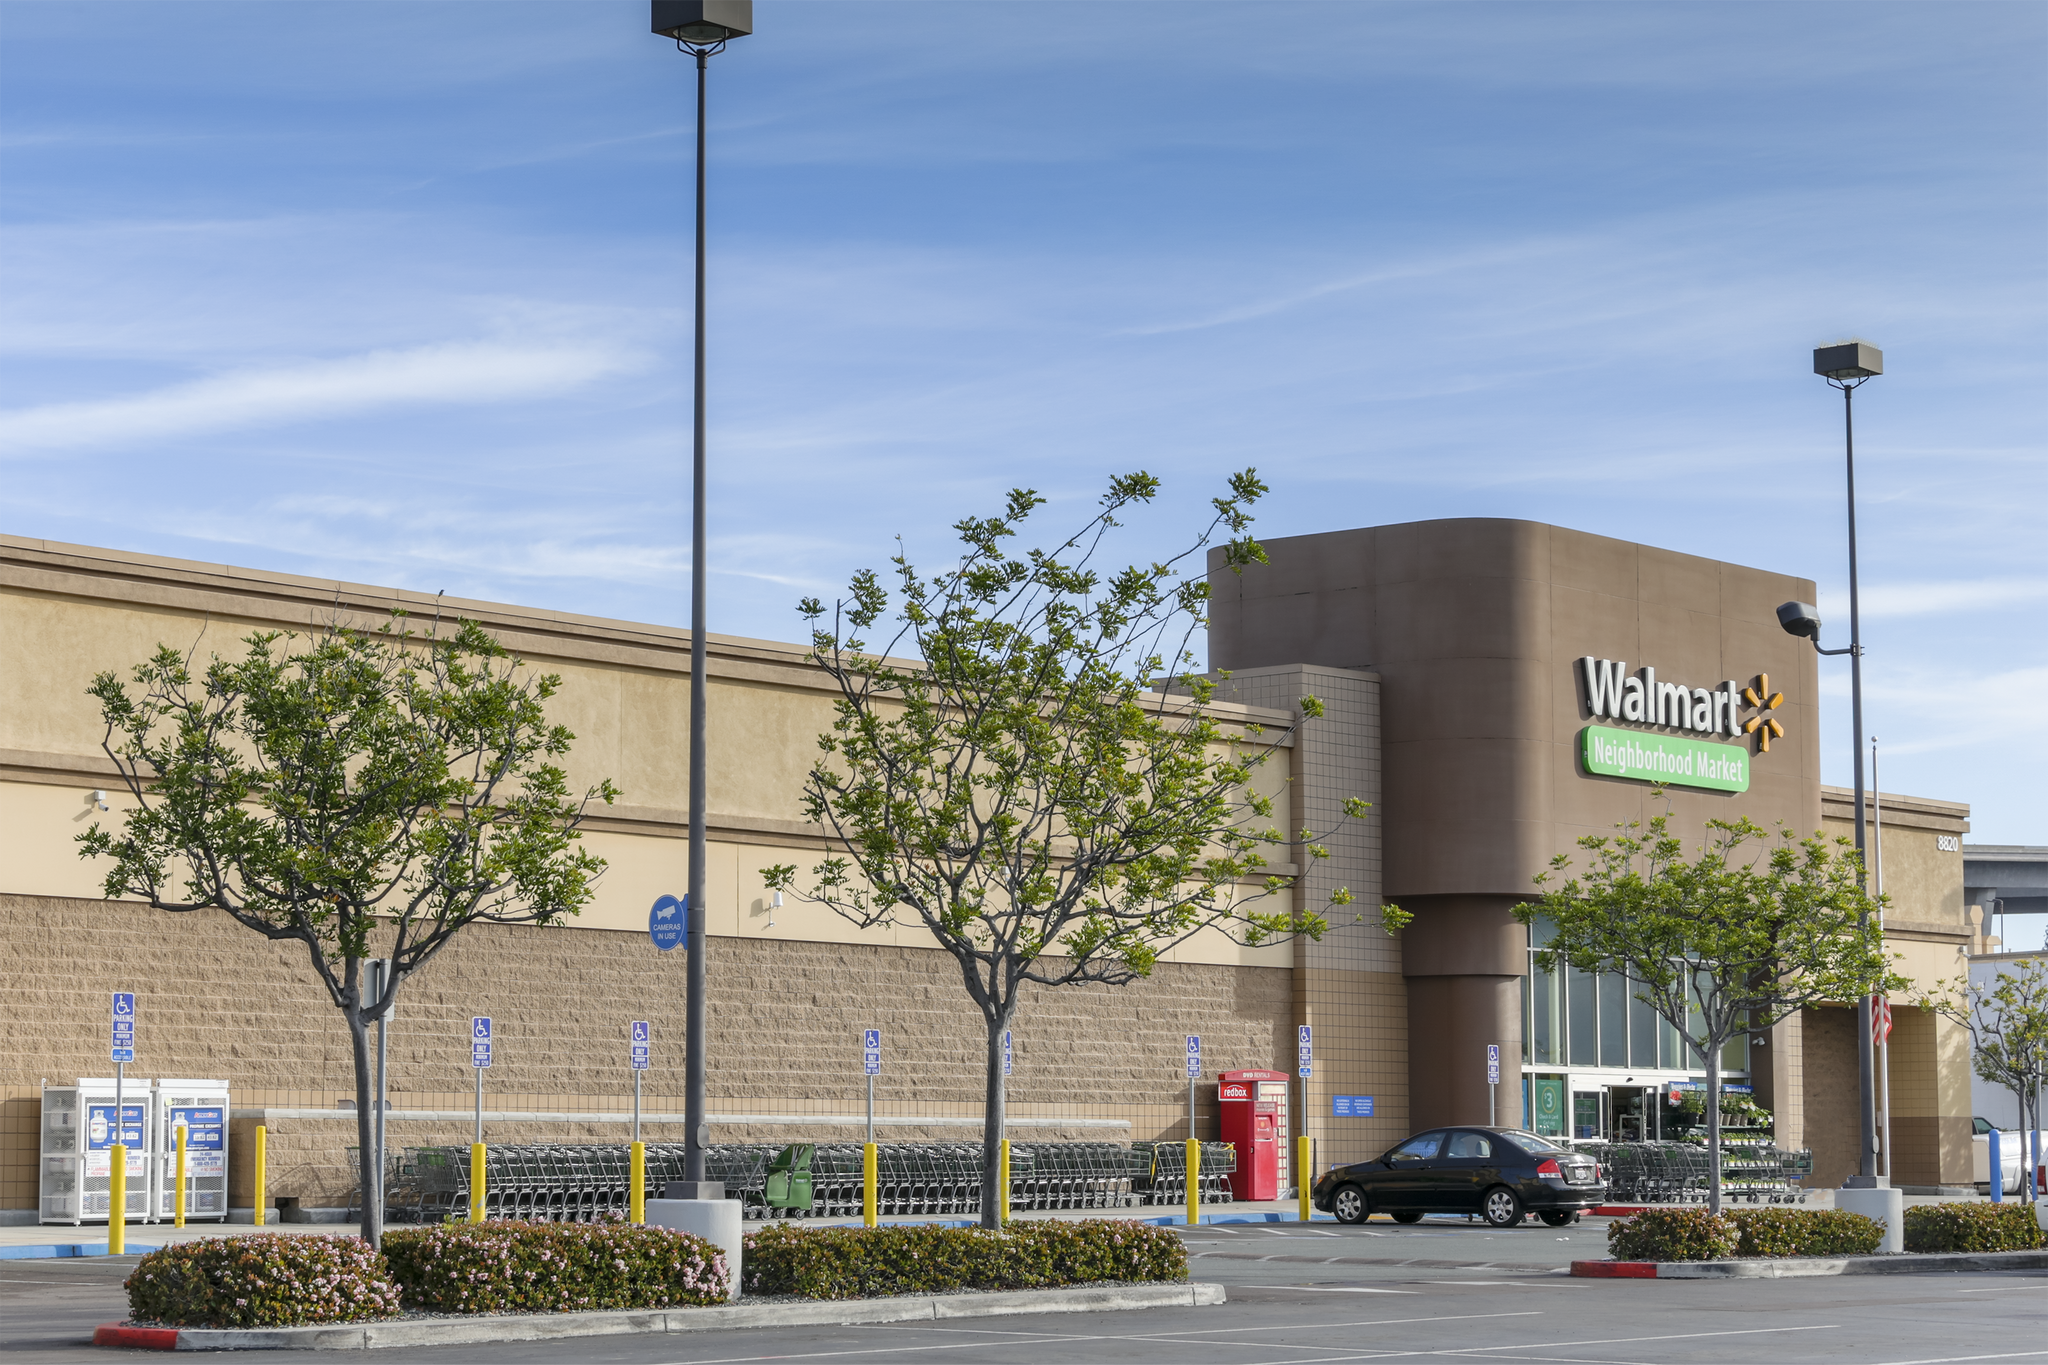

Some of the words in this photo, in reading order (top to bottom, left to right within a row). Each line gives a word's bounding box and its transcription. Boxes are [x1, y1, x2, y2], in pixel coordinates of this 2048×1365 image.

[1585, 656, 1741, 736] Walmart
[1594, 736, 1692, 776] Neighborhood
[1697, 751, 1743, 782] Market
[1938, 835, 1959, 852] 8820
[653, 923, 681, 931] CAMERAS
[657, 932, 664, 940] IN
[664, 932, 676, 940] USE
[113, 1014, 133, 1022] PARKING
[117, 1022, 129, 1031] ONLY
[473, 1036, 490, 1045] PARKING
[476, 1045, 487, 1053] ONLY
[635, 1047, 645, 1055] ONLY
[1224, 1087, 1247, 1097] redbox
[1544, 1092, 1552, 1108] $3
